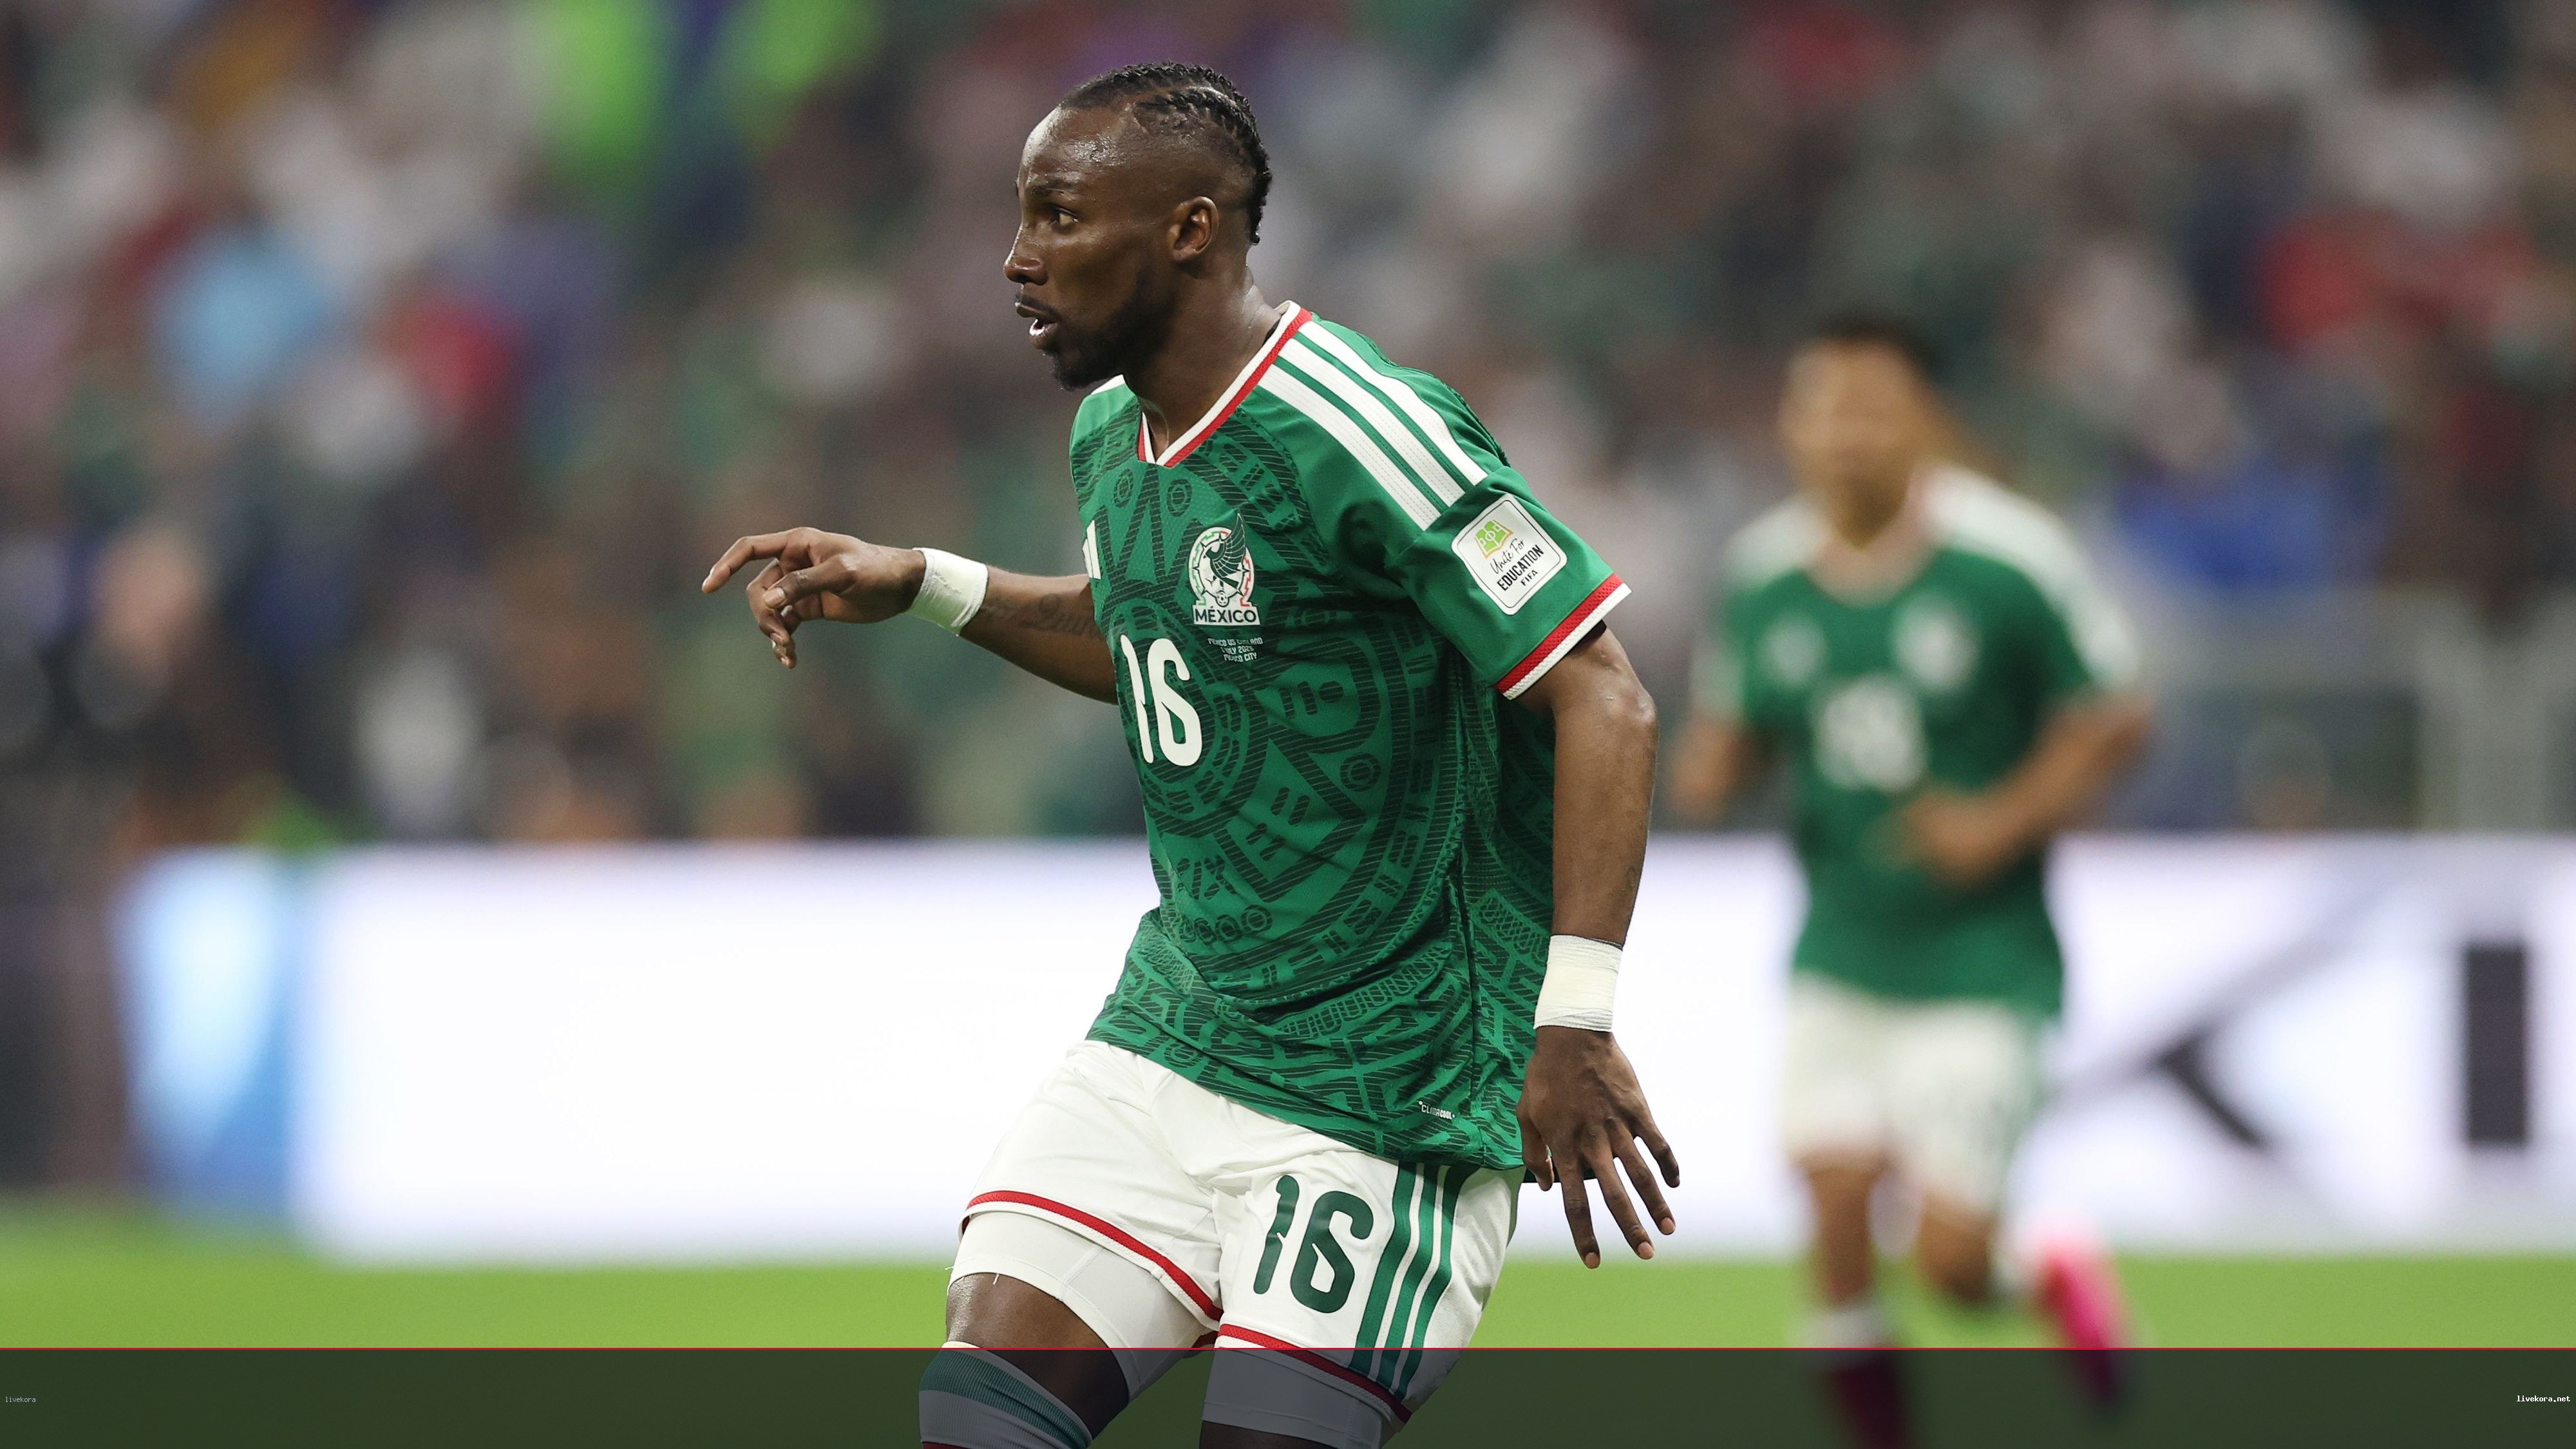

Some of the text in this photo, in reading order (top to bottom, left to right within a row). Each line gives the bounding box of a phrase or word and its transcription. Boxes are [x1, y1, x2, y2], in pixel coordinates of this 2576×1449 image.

[1490, 538, 1526, 574] Unite For
[1497, 545, 1544, 591] EDUCATION
[1520, 570, 1538, 586] FIFA
[1195, 606, 1256, 623] MÉXICO
[1244, 652, 1257, 661] CITY
[1120, 634, 1203, 766] 16
[1253, 1175, 1374, 1314] 16
